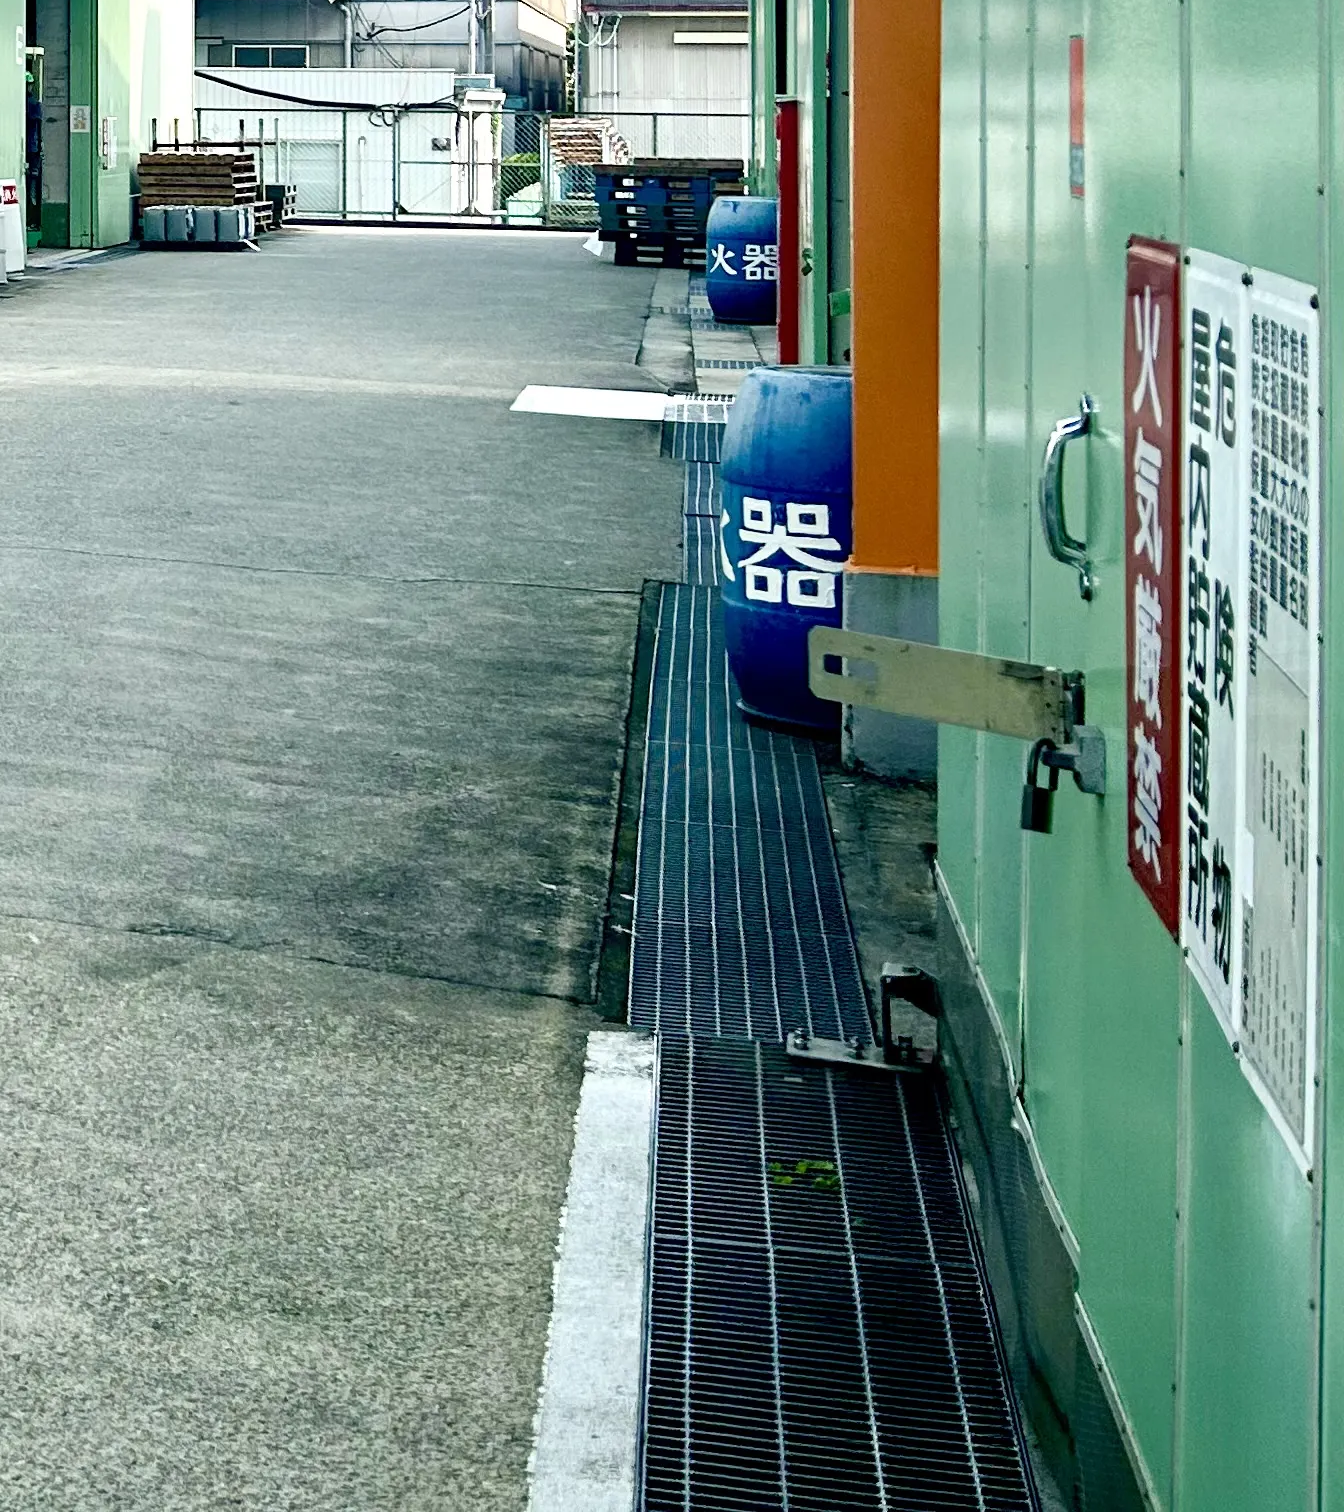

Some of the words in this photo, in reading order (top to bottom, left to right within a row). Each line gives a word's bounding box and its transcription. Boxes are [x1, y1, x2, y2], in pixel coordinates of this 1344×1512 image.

[720, 496, 844, 608] 器
[1132, 285, 1163, 885] 火気厳禁
[1188, 308, 1211, 944] 屋内貯蔵所
[1212, 317, 1236, 985] 危険物
